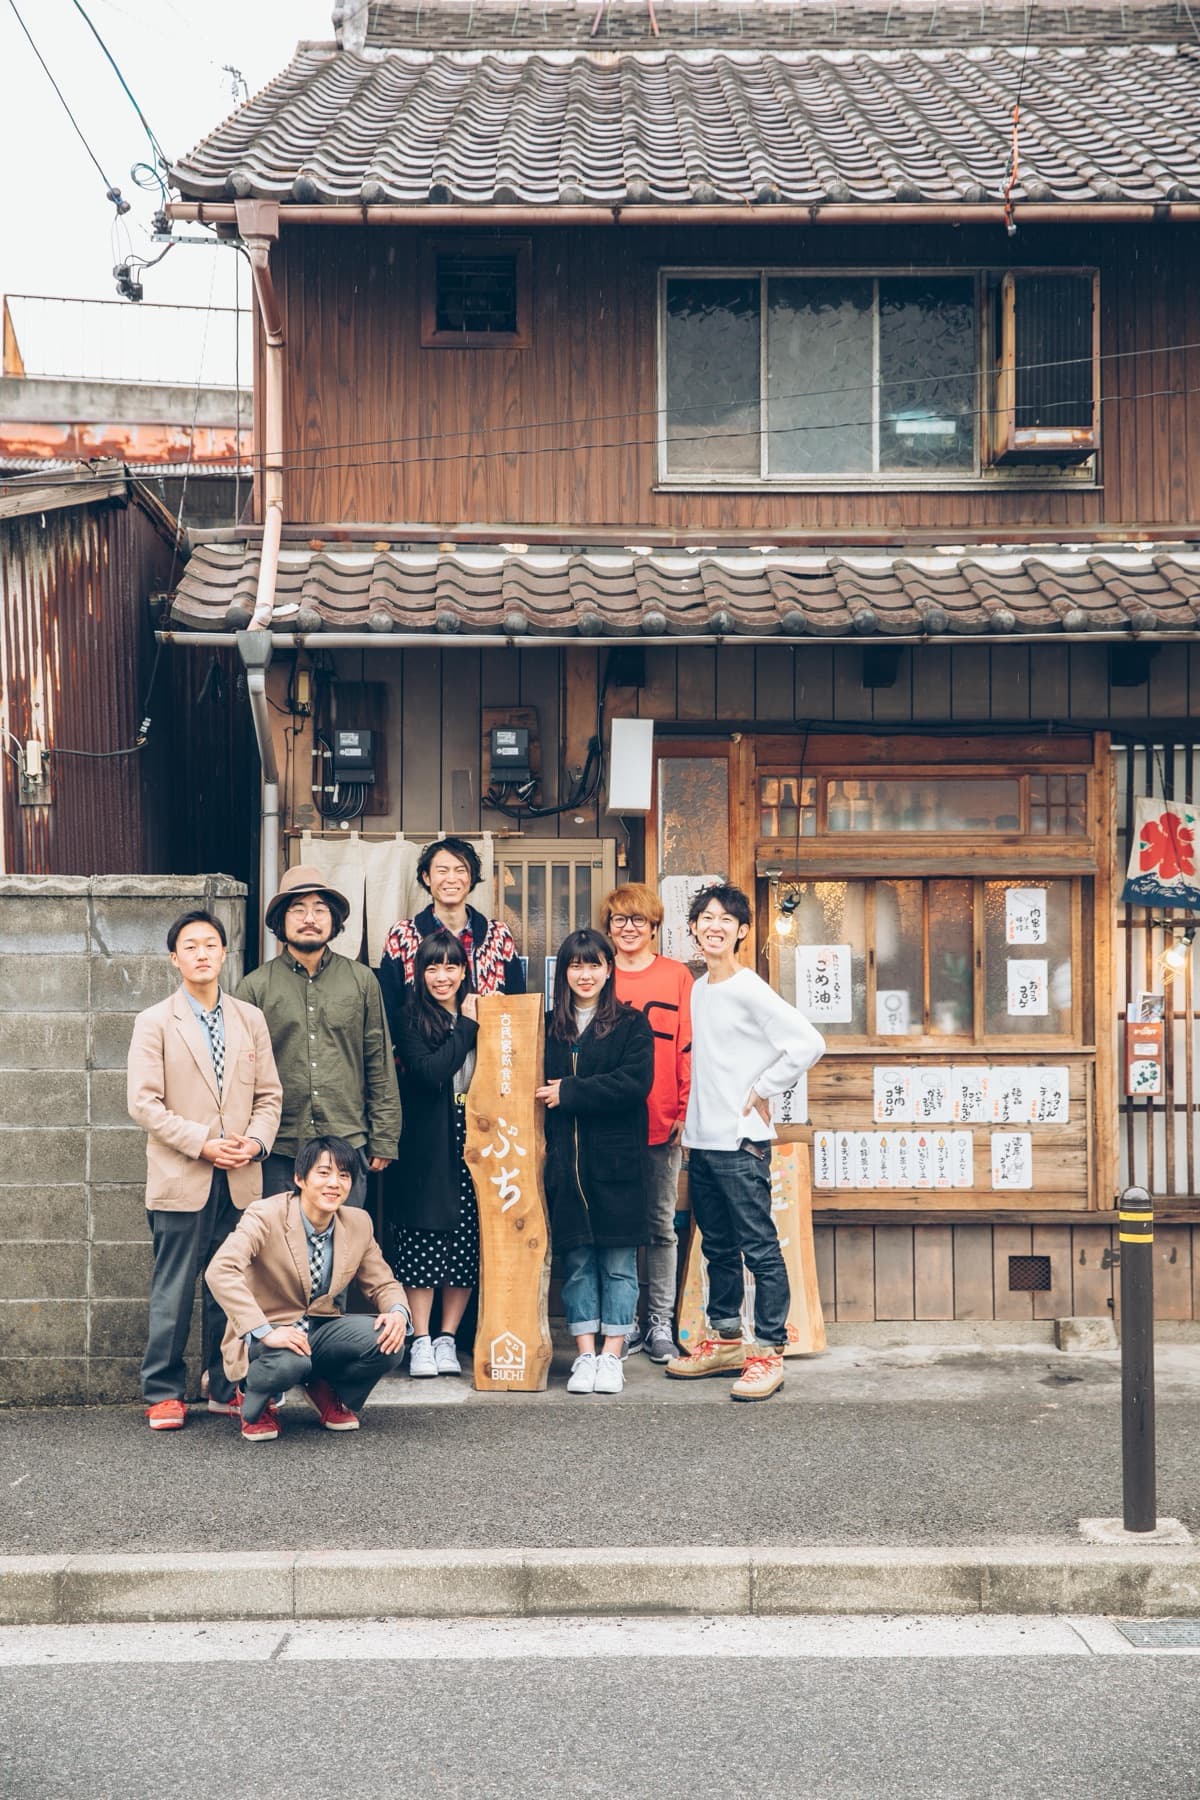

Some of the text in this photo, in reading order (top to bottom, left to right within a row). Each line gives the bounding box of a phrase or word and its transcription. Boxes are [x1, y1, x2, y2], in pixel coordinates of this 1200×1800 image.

[815, 960, 831, 1004] こめ油
[491, 1368, 525, 1381] BUCHI
